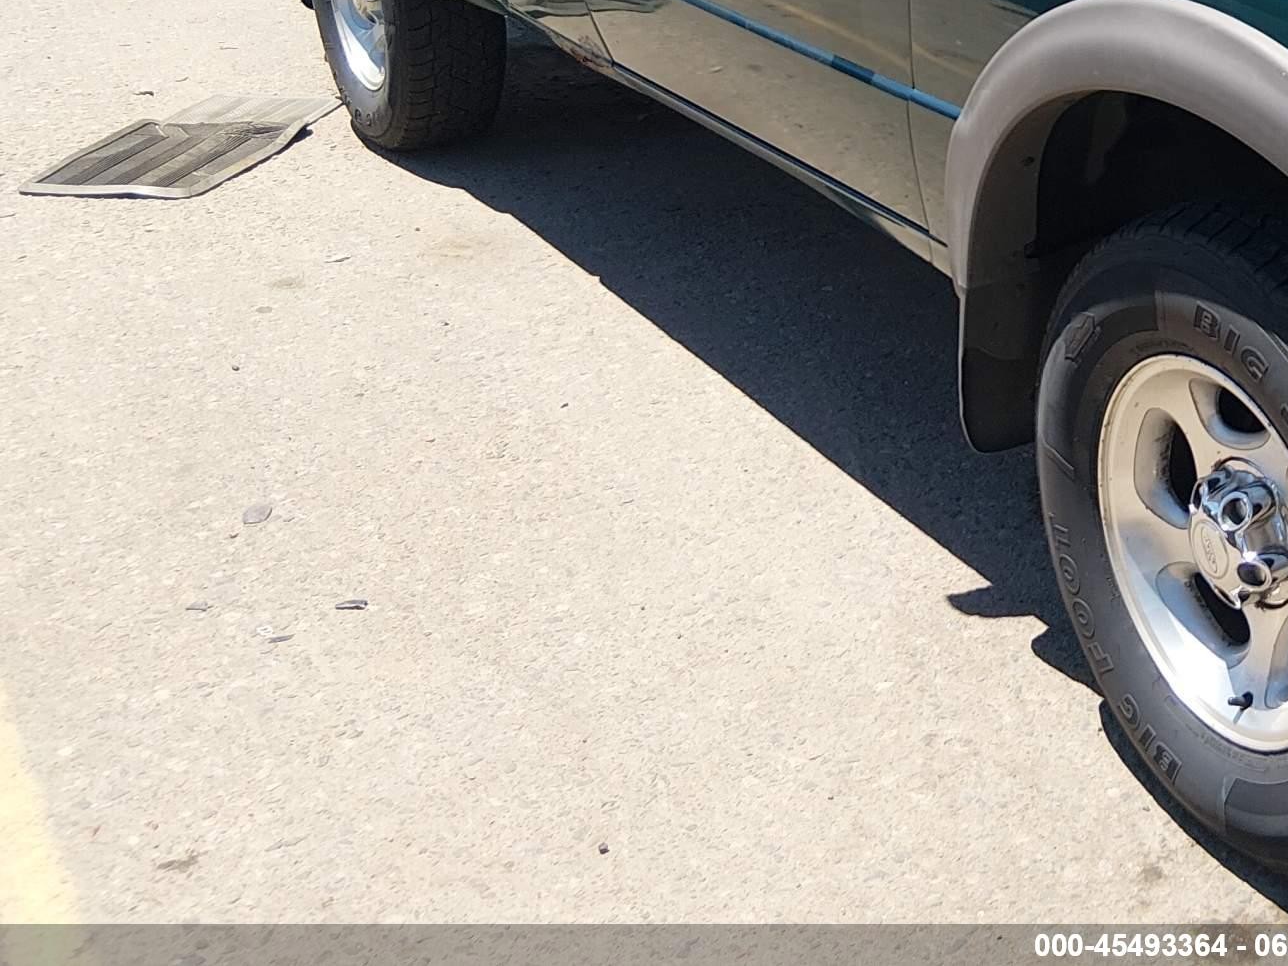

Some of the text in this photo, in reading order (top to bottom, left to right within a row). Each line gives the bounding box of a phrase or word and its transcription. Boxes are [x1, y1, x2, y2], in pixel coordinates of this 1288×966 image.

[1193, 301, 1270, 383] BIG
[1048, 511, 1183, 785] BIG FOOT
